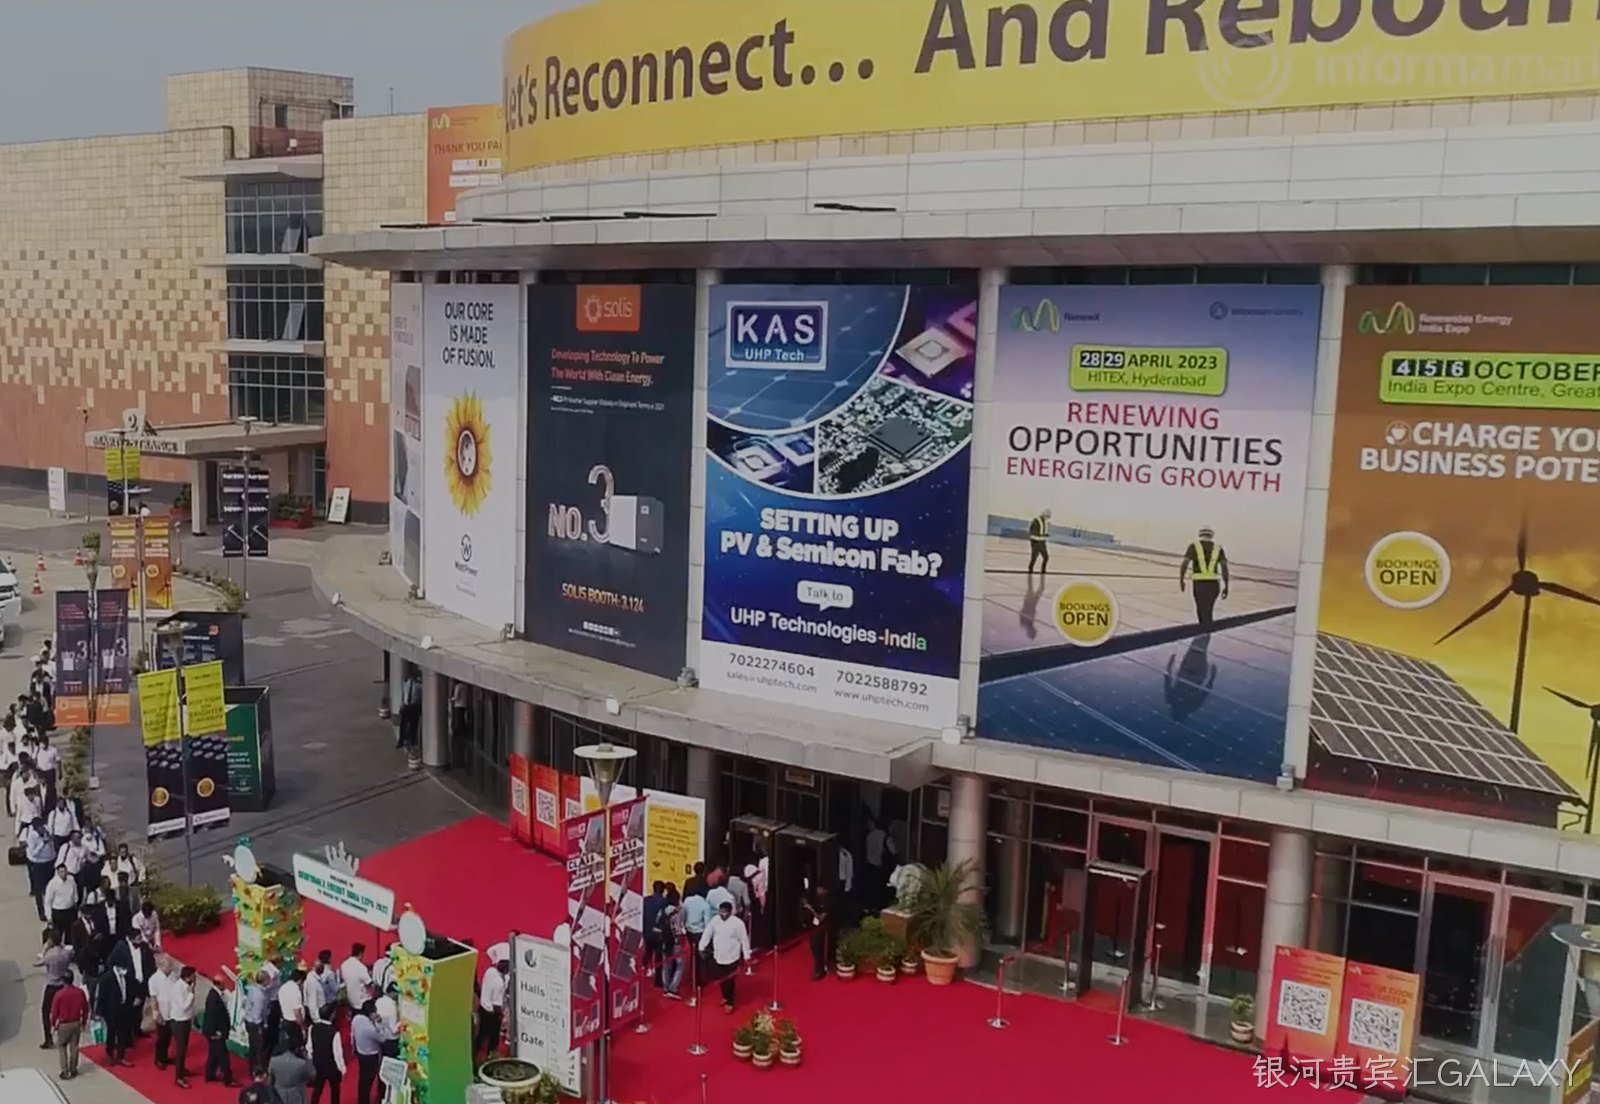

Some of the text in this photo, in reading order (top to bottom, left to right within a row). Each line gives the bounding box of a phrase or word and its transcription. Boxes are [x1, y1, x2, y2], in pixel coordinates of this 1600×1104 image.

[913, 0, 1108, 73] And
[433, 143, 464, 154] THANK
[466, 141, 486, 152] YOU
[445, 302, 494, 321] OUR CORE
[603, 298, 632, 318] solis
[737, 313, 815, 344] KAS
[1444, 323, 1471, 335] Expo
[1475, 314, 1513, 326] Energy
[449, 324, 488, 344] IS MADE
[442, 346, 495, 369] OF FUSION.
[551, 348, 665, 366] Developing Technology To Power
[745, 348, 805, 361] UHP Tech
[1082, 352, 1218, 370] 28 29 APRIL 2023
[551, 367, 564, 379] The
[565, 367, 587, 381] World
[587, 369, 604, 382] With
[1396, 360, 1410, 375] 4
[1424, 360, 1438, 376] 5
[1450, 360, 1465, 376] 6
[1088, 370, 1207, 387] HITEX, Hyderabad
[1387, 380, 1428, 394] India
[1433, 381, 1476, 397] Expo
[1481, 381, 1545, 398] Centre,
[1067, 401, 1220, 430] RENEWING
[1412, 421, 1600, 452] CHARGE YO
[1008, 426, 1283, 467] OPPORTUNITIES
[1006, 456, 1281, 492] ENERGIZING GROWTH
[1360, 447, 1600, 483] BUSINESS POTE
[760, 507, 900, 542] SETTING UP
[720, 531, 943, 577] PV & Semicon Fab?
[1375, 558, 1440, 570] BOOKINGS
[1379, 569, 1438, 586] OPEN
[562, 583, 587, 601] SOLIS
[806, 586, 844, 601] Talk to
[1059, 602, 1111, 613] BOOKINGS
[730, 607, 766, 627] UHP
[1062, 612, 1109, 627] OPEN
[729, 652, 929, 697] 7022274604 7022588792
[520, 980, 546, 997] Halls
[520, 1032, 545, 1048] Gate
